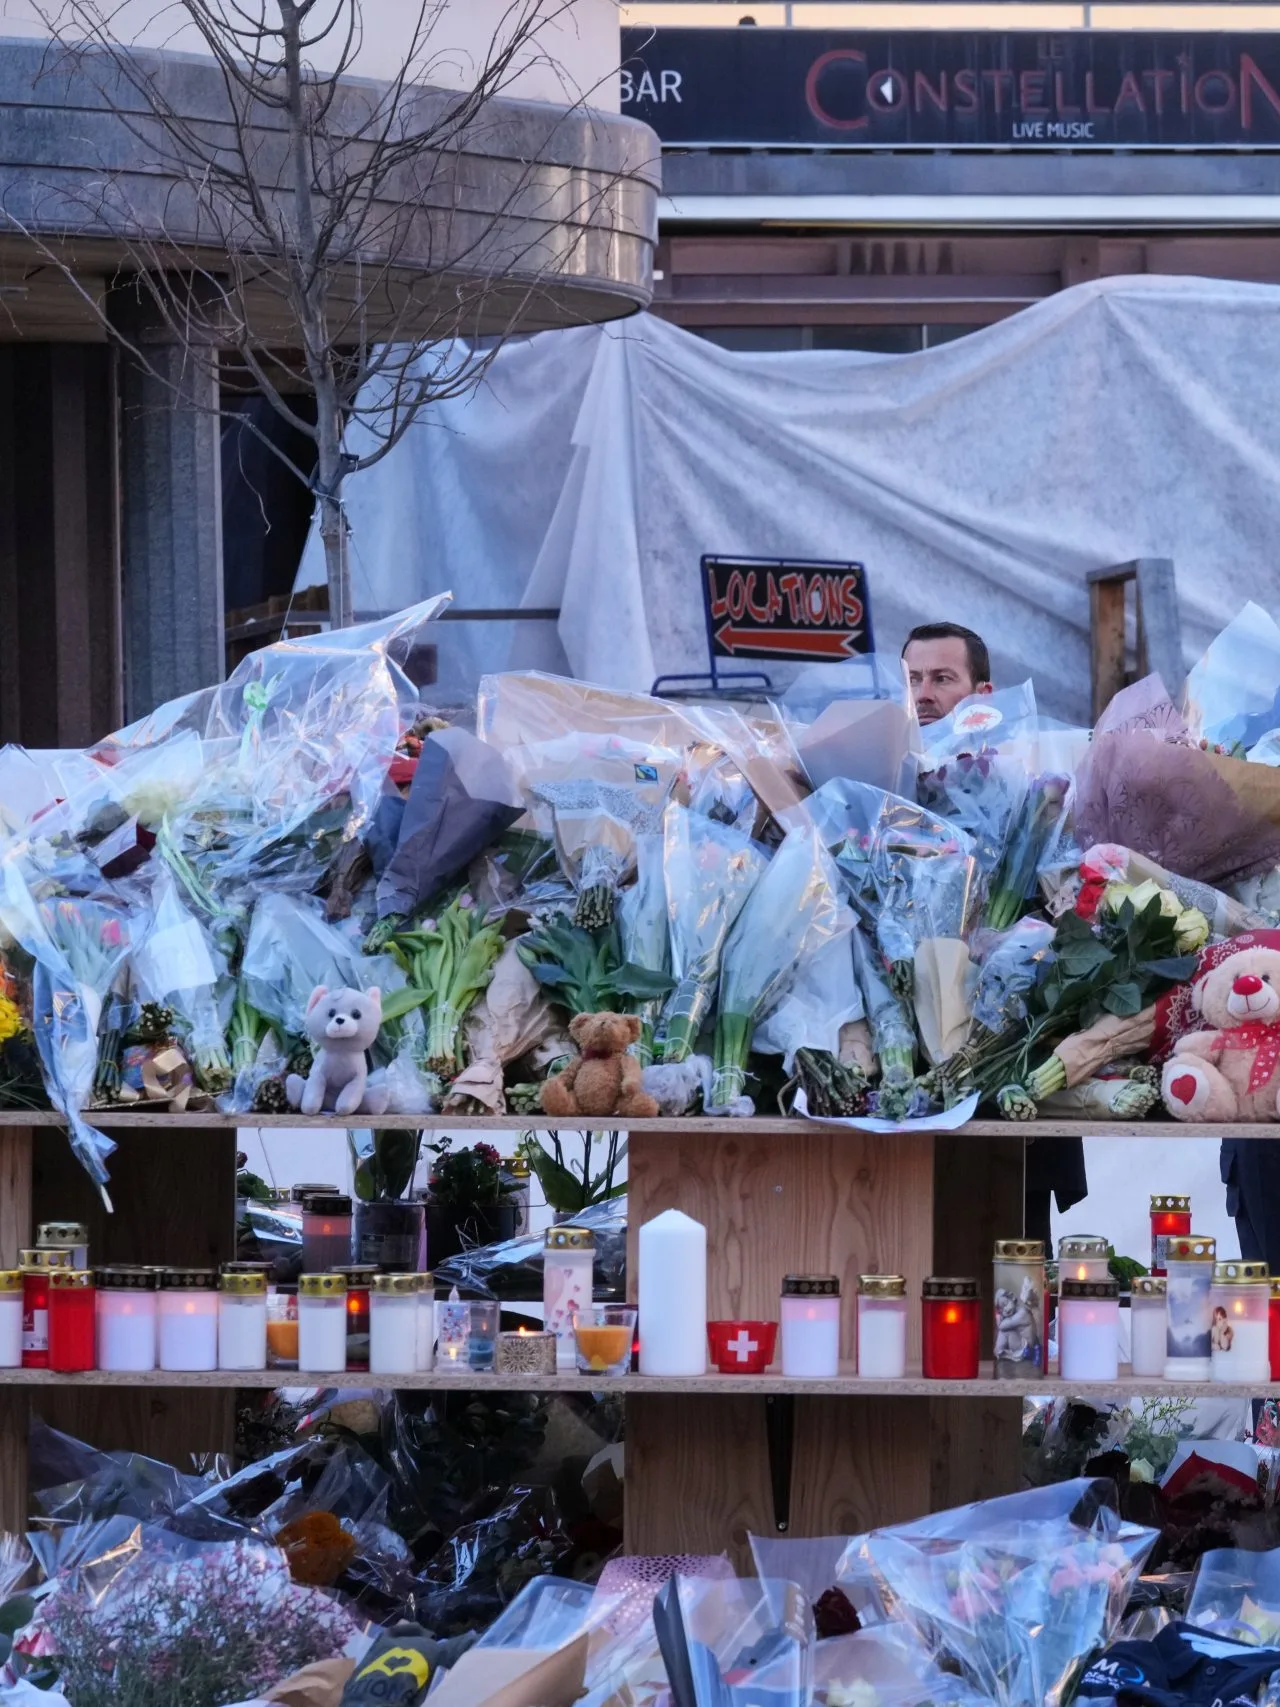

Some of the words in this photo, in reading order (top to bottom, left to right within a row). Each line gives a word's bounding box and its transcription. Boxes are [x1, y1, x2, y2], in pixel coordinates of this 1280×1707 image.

[620, 70, 683, 103] BAR
[1012, 121, 1043, 138] LIVE
[1047, 122, 1094, 139] MUSIC
[709, 568, 863, 627] LOCATIONS
